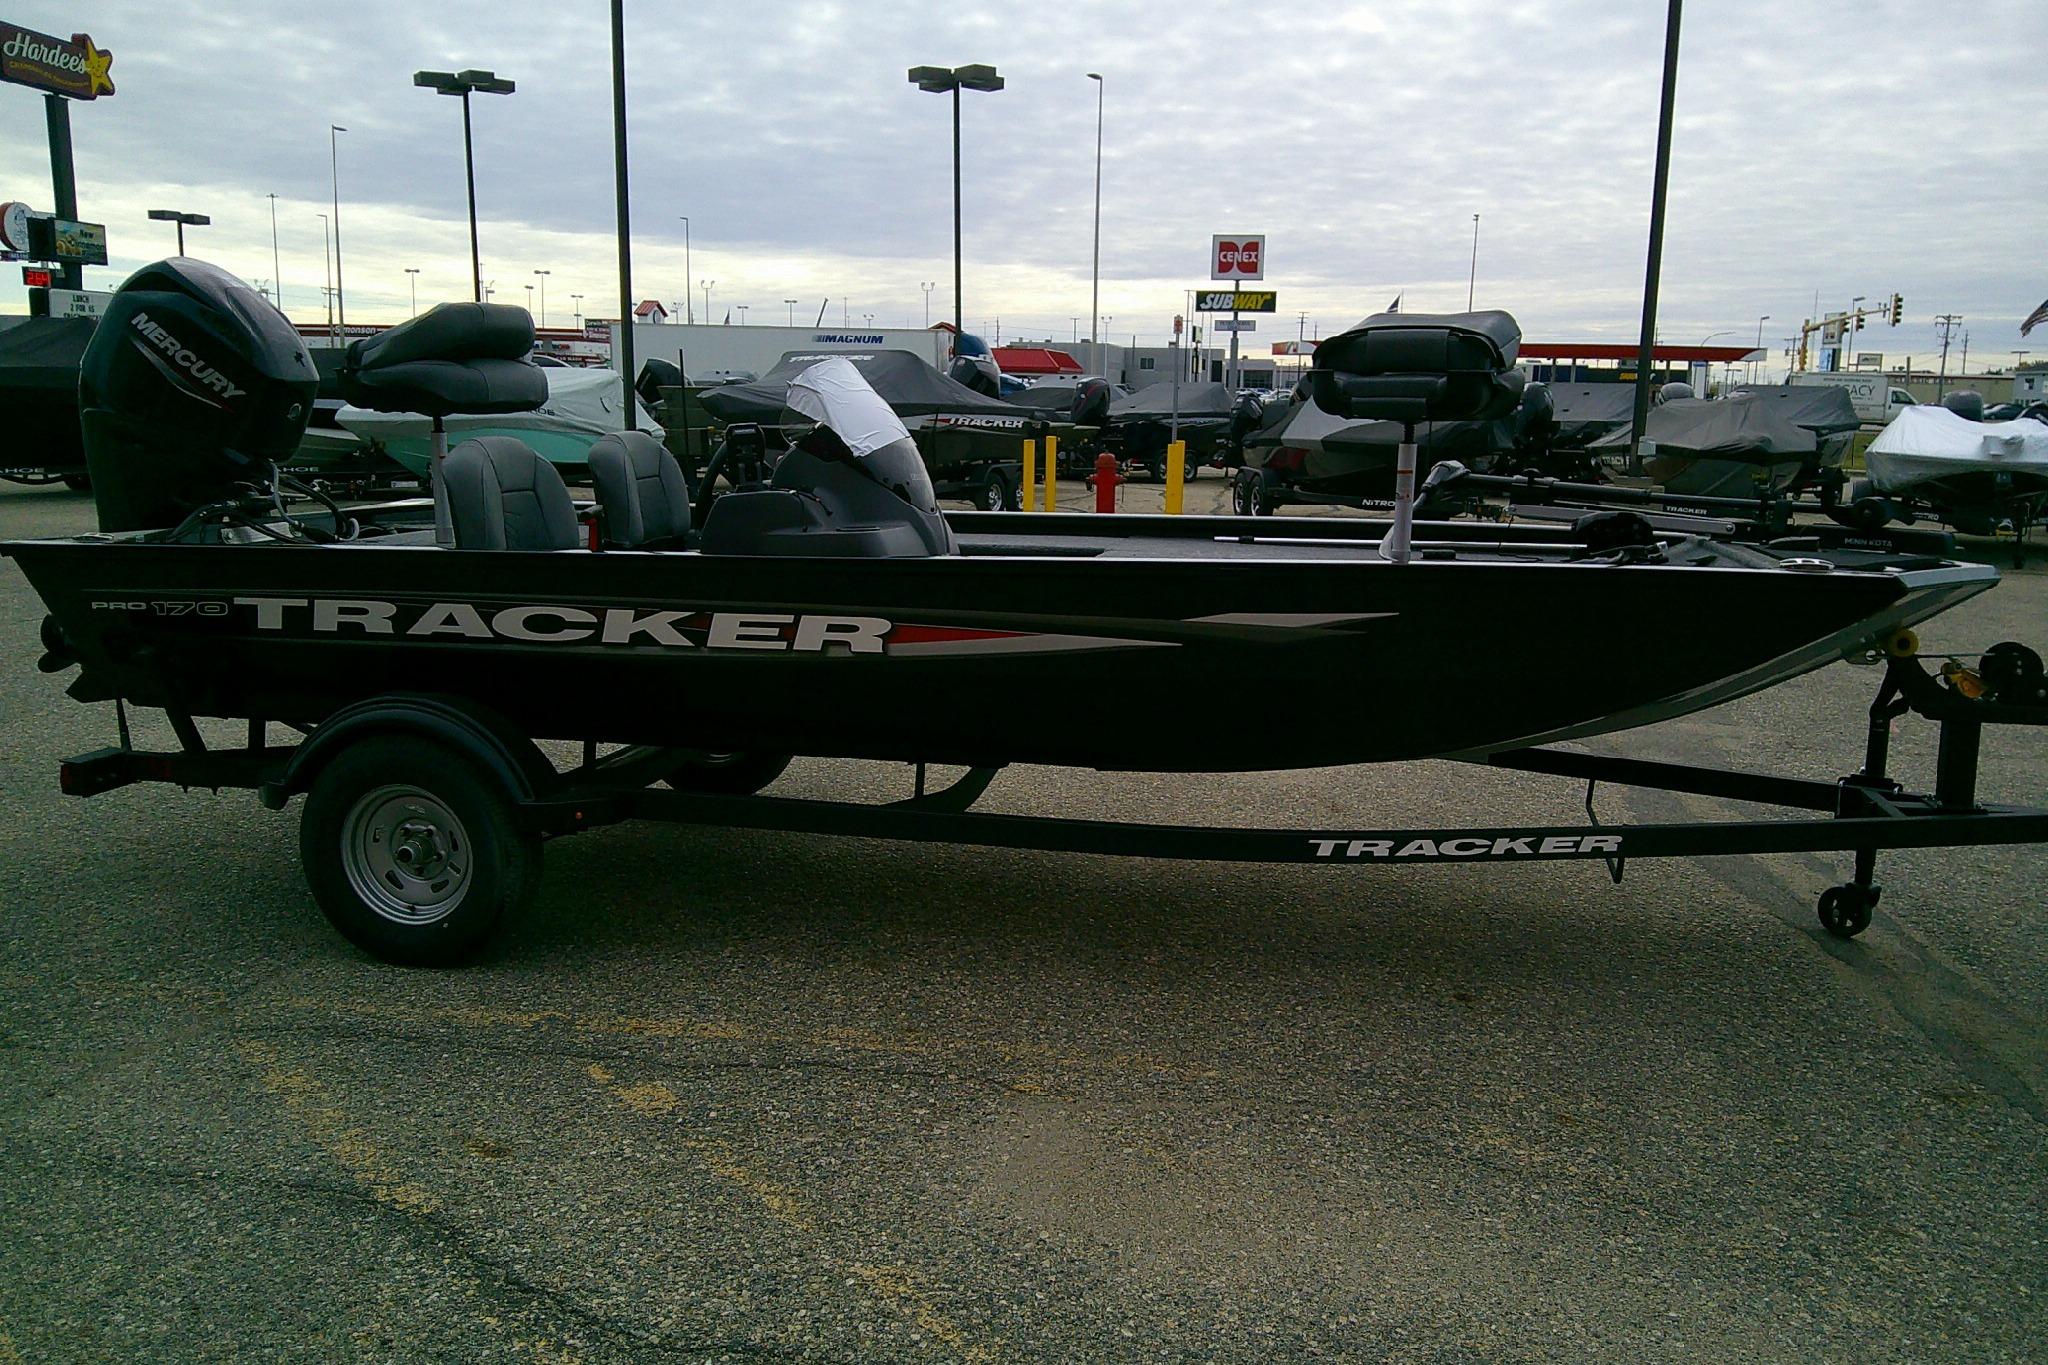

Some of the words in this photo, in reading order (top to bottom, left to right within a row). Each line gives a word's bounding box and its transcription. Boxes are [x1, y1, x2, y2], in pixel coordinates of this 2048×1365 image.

[3, 32, 87, 74] Hardee's
[1220, 251, 1258, 262] CENEX
[1200, 293, 1271, 309] SUBWAY
[824, 335, 883, 344] MAGNUM
[131, 312, 246, 398] MERCURY
[949, 417, 1024, 429] TRACKER
[1666, 505, 1708, 515] TRACKER
[91, 602, 147, 610] PRO
[151, 601, 229, 616] 170
[233, 597, 891, 653] TRACKER
[1308, 835, 1623, 857] TRACKER
